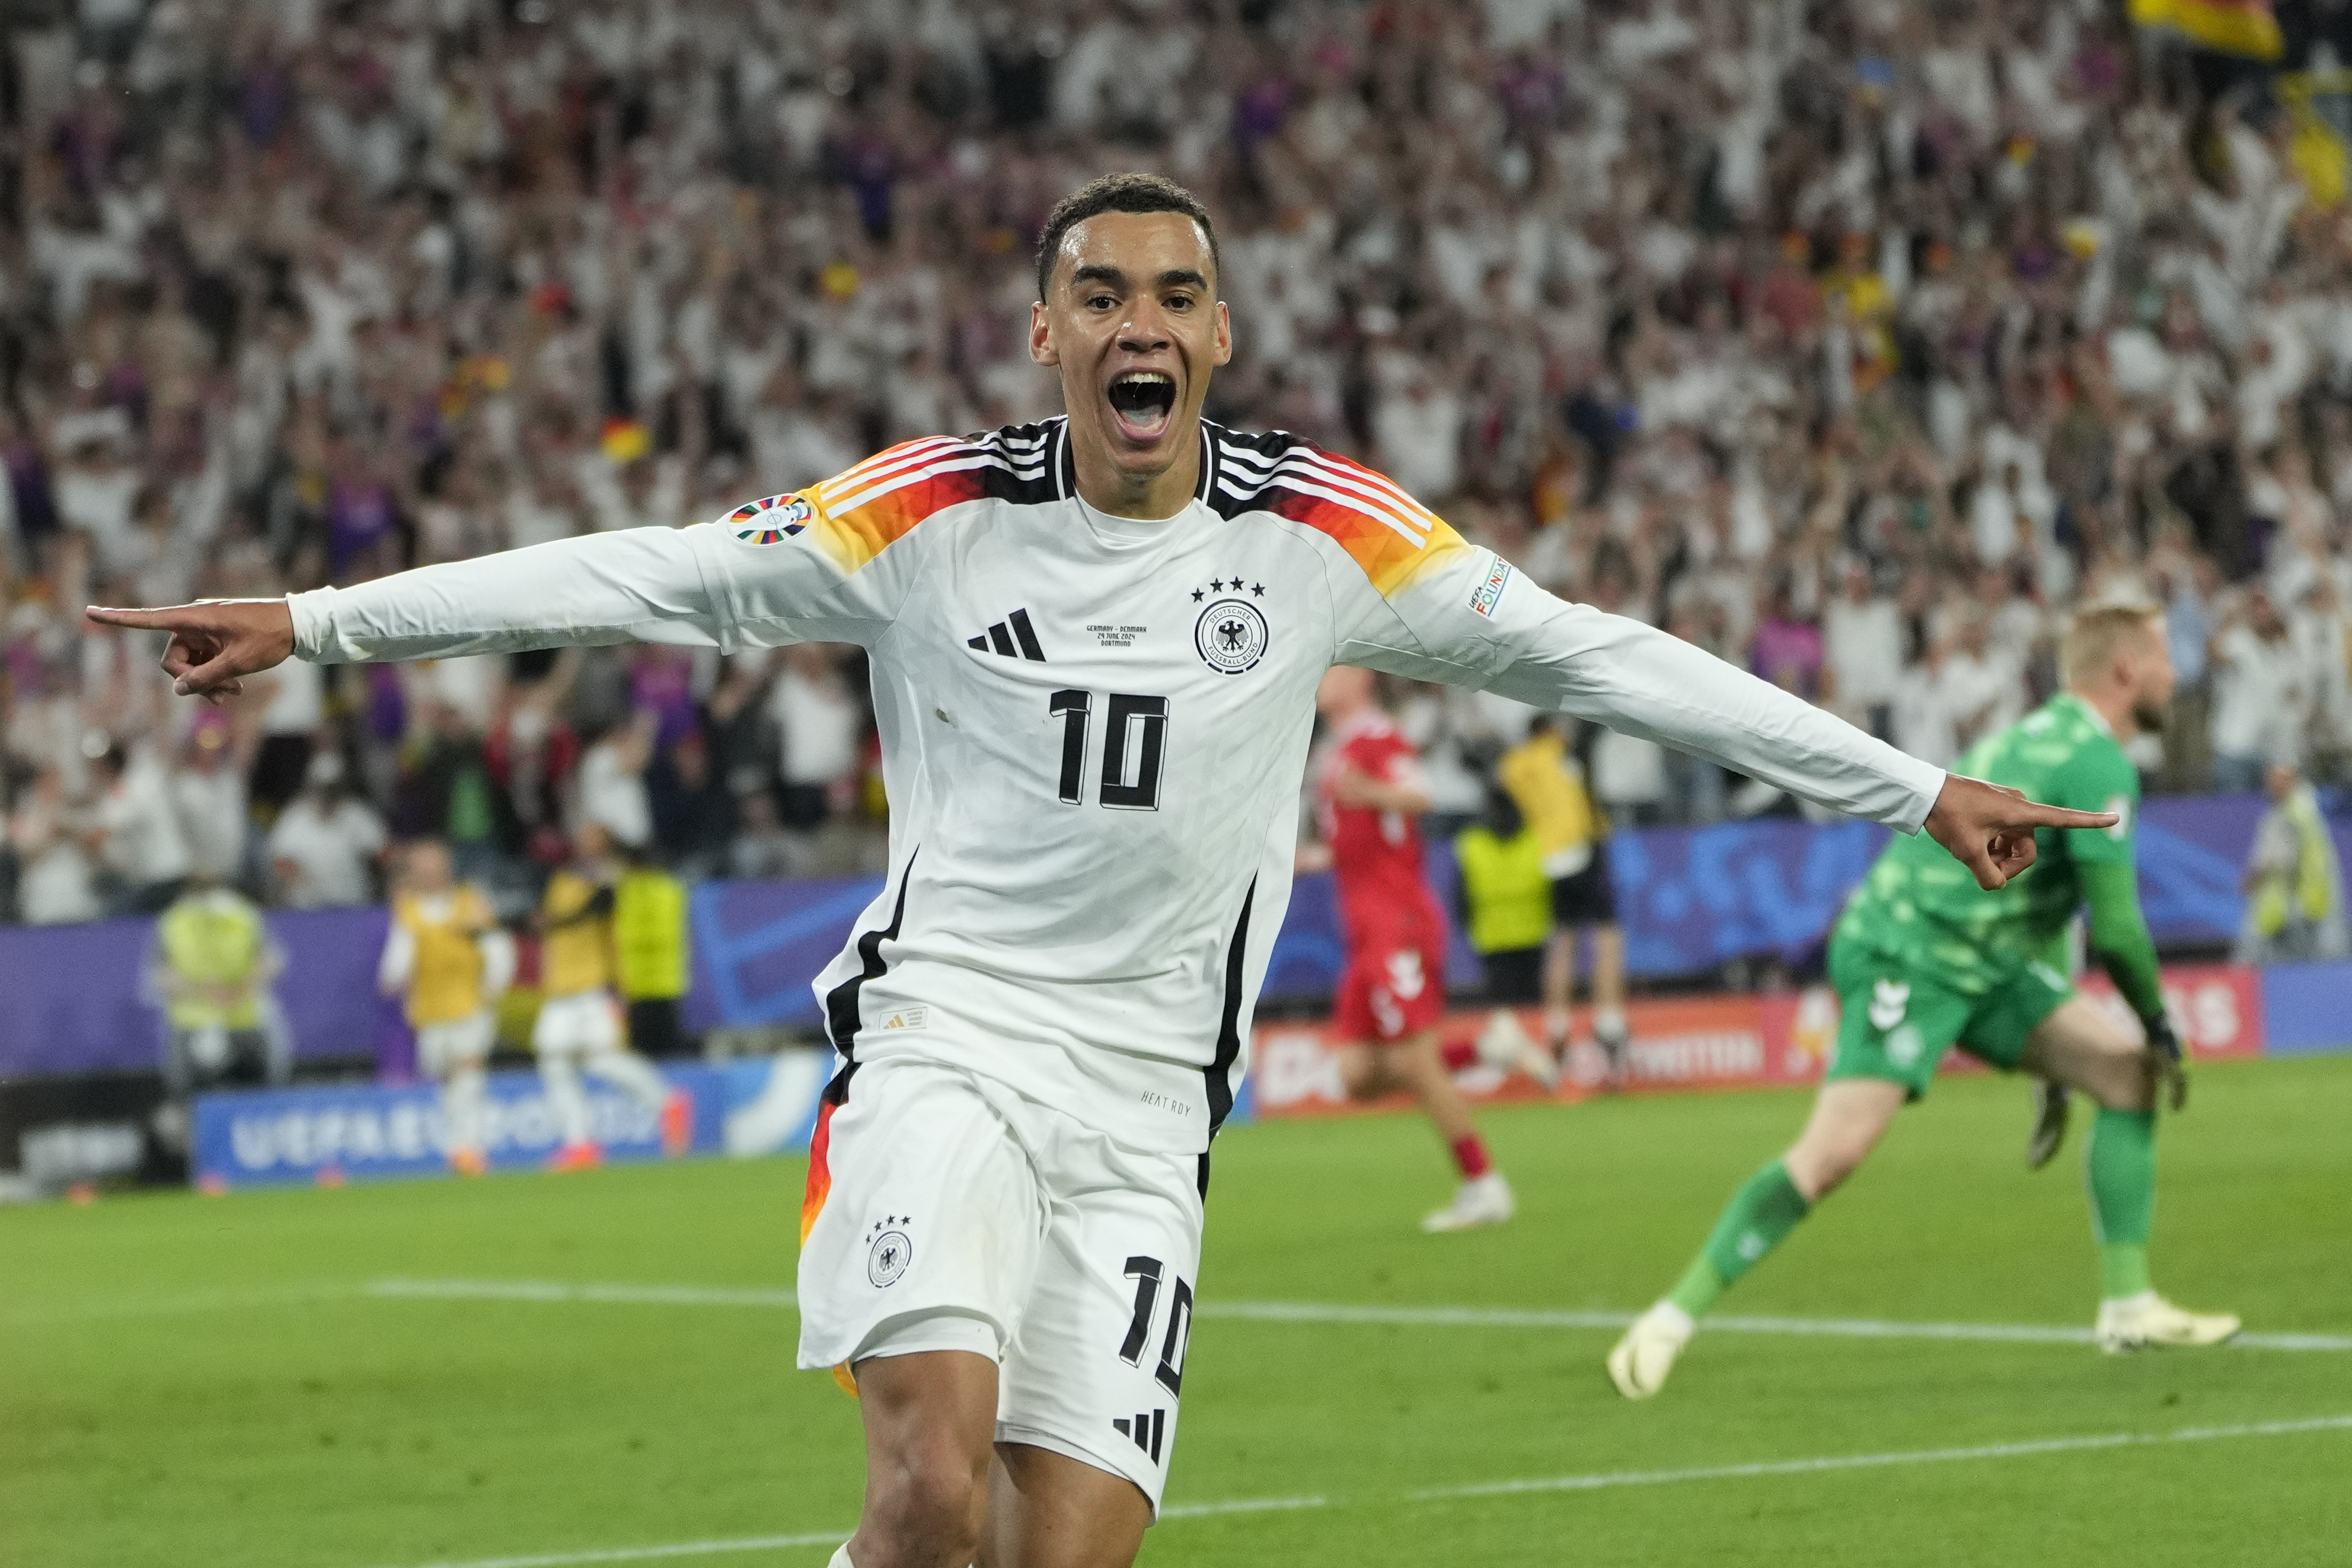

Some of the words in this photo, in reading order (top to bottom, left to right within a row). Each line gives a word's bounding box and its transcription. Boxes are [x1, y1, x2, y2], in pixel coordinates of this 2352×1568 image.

[1469, 586, 1483, 608] UEFA
[1209, 608, 1251, 624] DEUTSCHER
[1207, 642, 1258, 665] FUSSBALL-BUND
[1049, 689, 1170, 812] 10
[1119, 1256, 1193, 1405] 10
